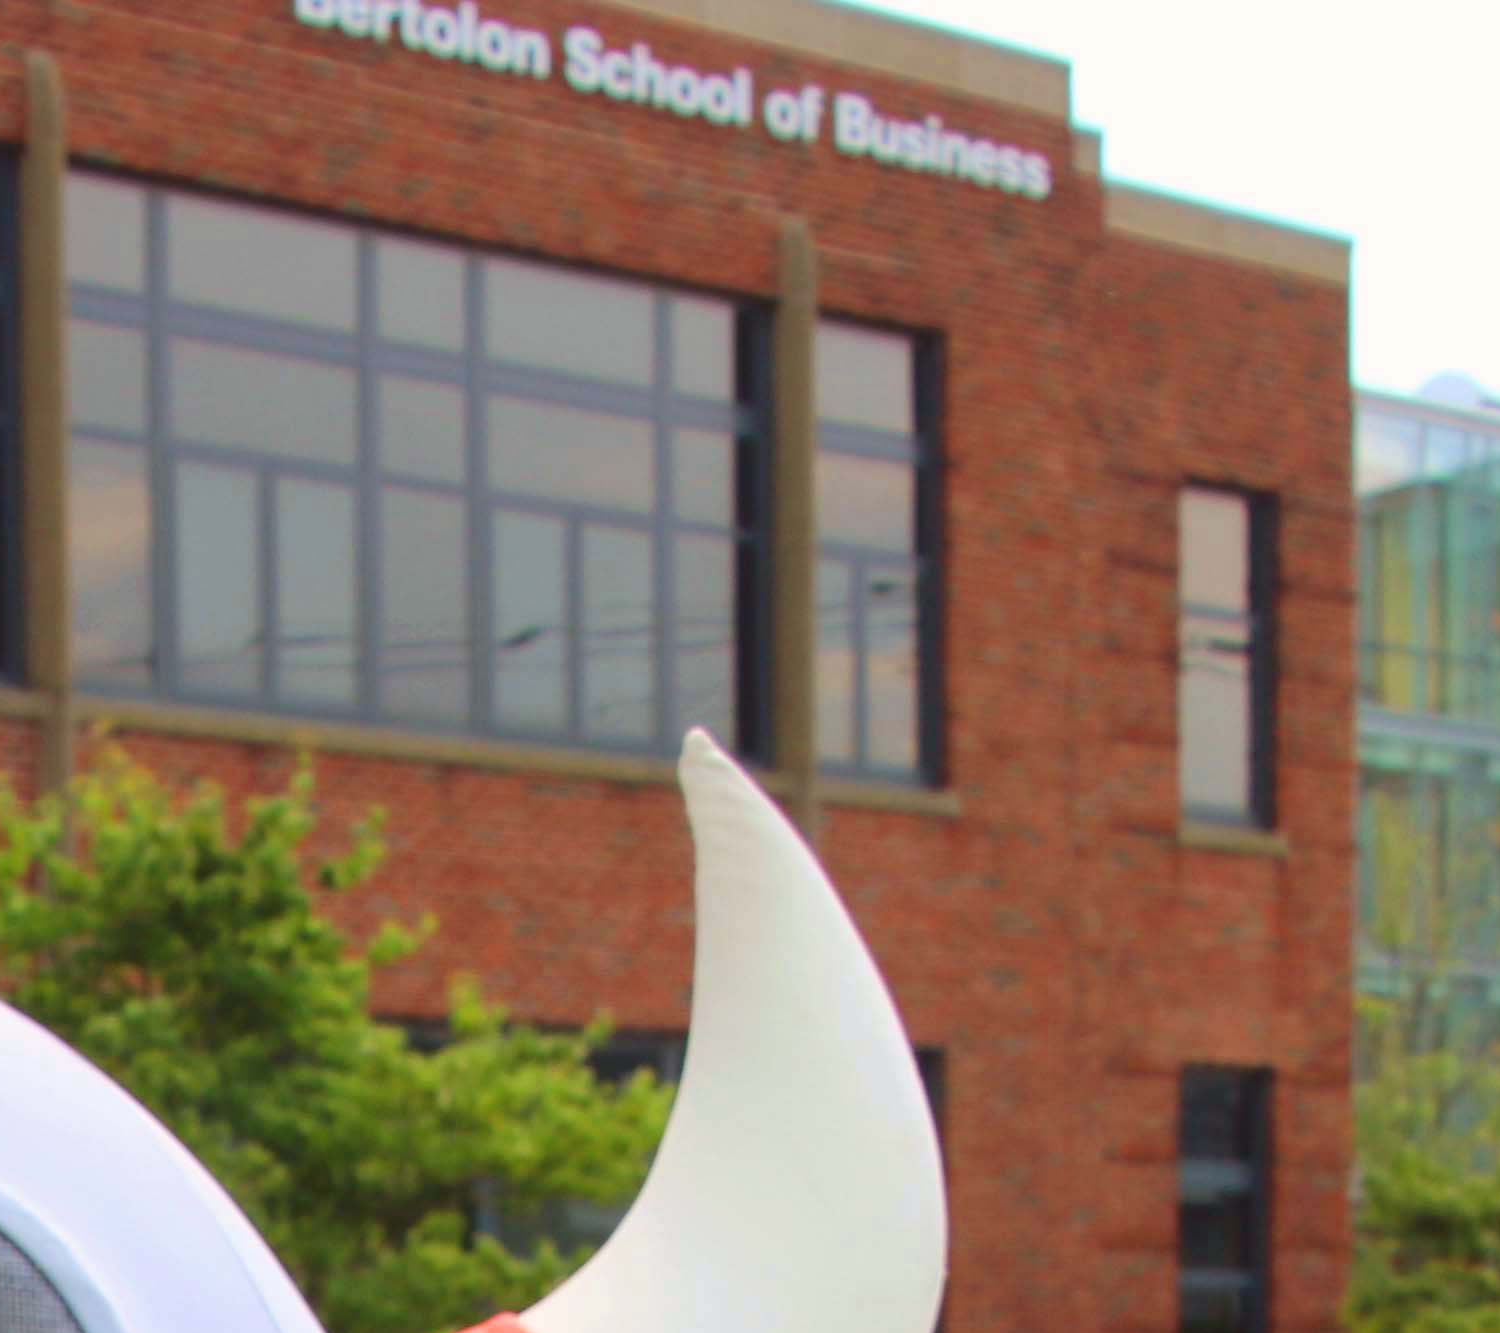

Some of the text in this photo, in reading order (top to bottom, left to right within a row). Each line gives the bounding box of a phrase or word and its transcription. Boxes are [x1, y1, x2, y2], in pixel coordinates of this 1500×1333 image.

[563, 25, 752, 128] School
[764, 86, 823, 143] of
[833, 92, 1051, 200] Business
